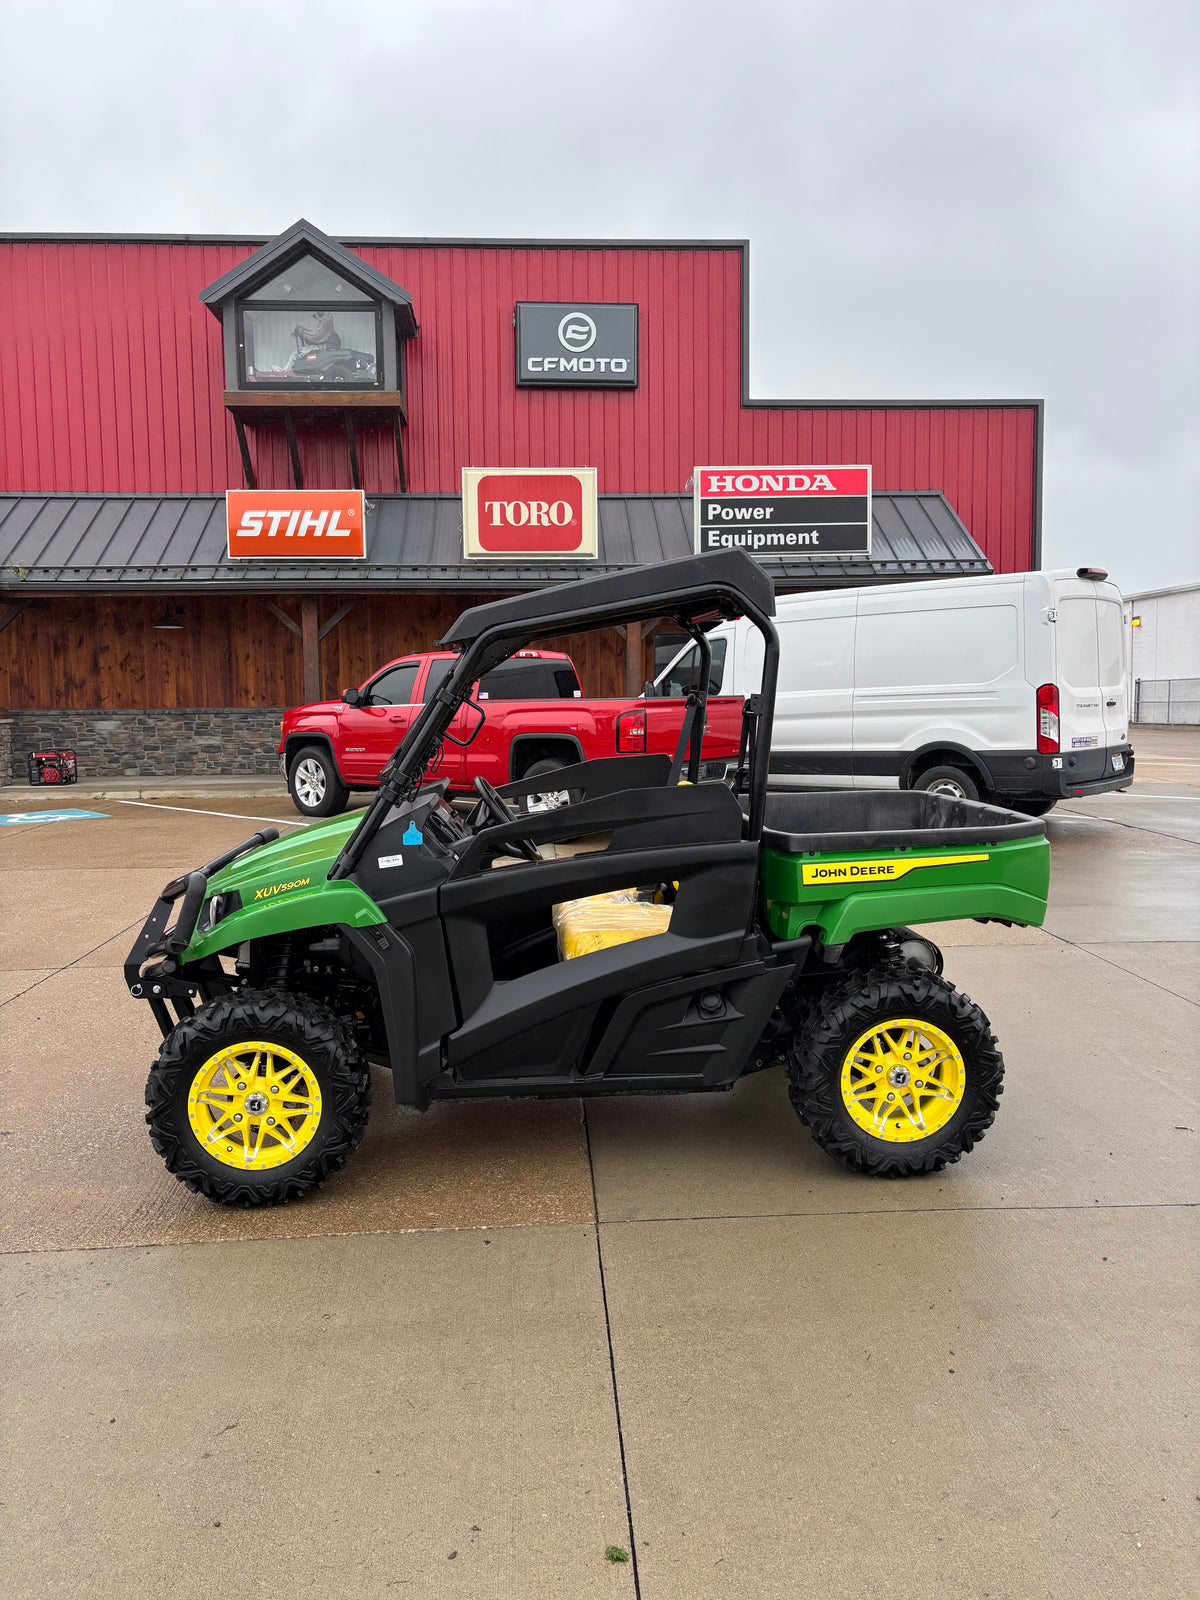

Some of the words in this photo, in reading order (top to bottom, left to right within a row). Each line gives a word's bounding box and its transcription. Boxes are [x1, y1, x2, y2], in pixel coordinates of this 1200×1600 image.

[527, 357, 628, 373] CFMOTO
[707, 474, 837, 493] HONDA
[484, 500, 573, 527] TORO
[707, 503, 774, 521] Power
[235, 509, 351, 537] STIHL
[708, 529, 820, 550] Equipment
[811, 868, 846, 878] JOHN
[850, 866, 894, 876] DEERE
[253, 877, 311, 900] XUV590M
